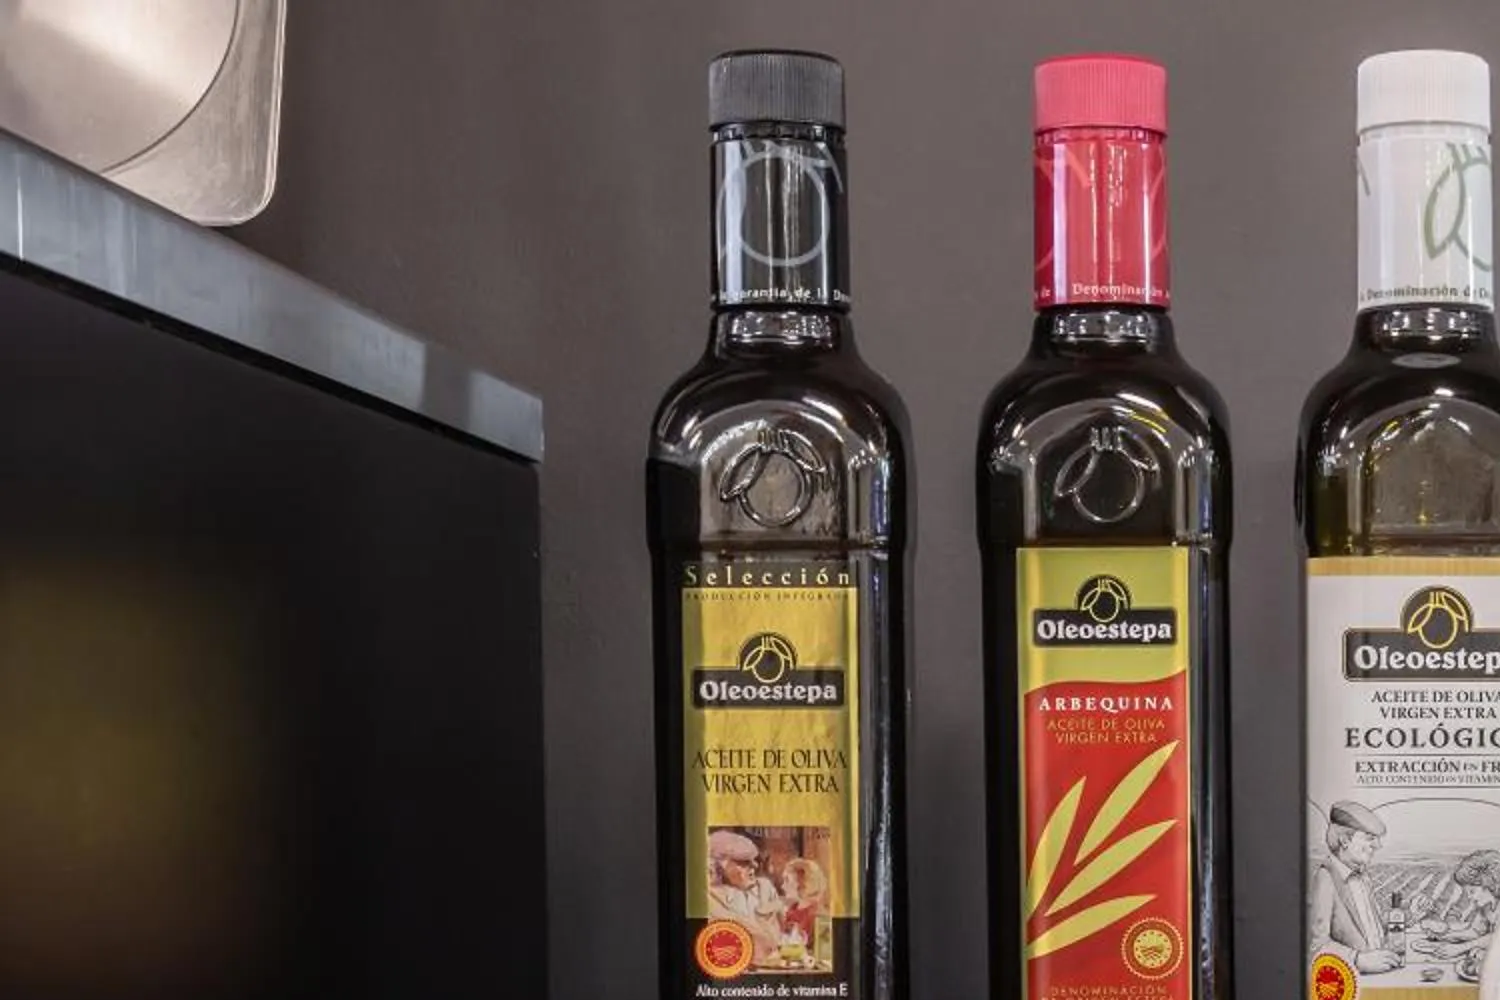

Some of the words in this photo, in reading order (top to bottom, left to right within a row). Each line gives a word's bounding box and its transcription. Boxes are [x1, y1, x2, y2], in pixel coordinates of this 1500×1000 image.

[684, 565, 850, 586] Selección
[1036, 619, 1173, 643] Oleoestepa
[699, 681, 838, 704] Oleoestepa
[1371, 690, 1429, 704] ACEITE
[1432, 690, 1454, 704] DE
[1038, 697, 1174, 714] ARBEQUINA
[1379, 706, 1440, 720] VIRGEN
[1443, 706, 1498, 720] EXTRA
[1046, 717, 1097, 731] ACEITE
[1100, 717, 1118, 731] DE
[1124, 717, 1166, 731] OLIVA
[1054, 731, 1111, 744] VIRGEN
[1114, 732, 1158, 744] EXTRA
[691, 749, 757, 769] ACEITE
[762, 749, 786, 769] DE
[790, 749, 848, 769] OLIVA
[1354, 757, 1461, 774] EXTRACCIÓN
[701, 773, 772, 794] VIRGEN
[779, 773, 840, 794] EXTRA
[695, 983, 719, 998] Alto
[721, 983, 775, 998] contenido
[776, 983, 791, 998] de
[793, 984, 837, 998] vitamina
[838, 982, 849, 998] E
